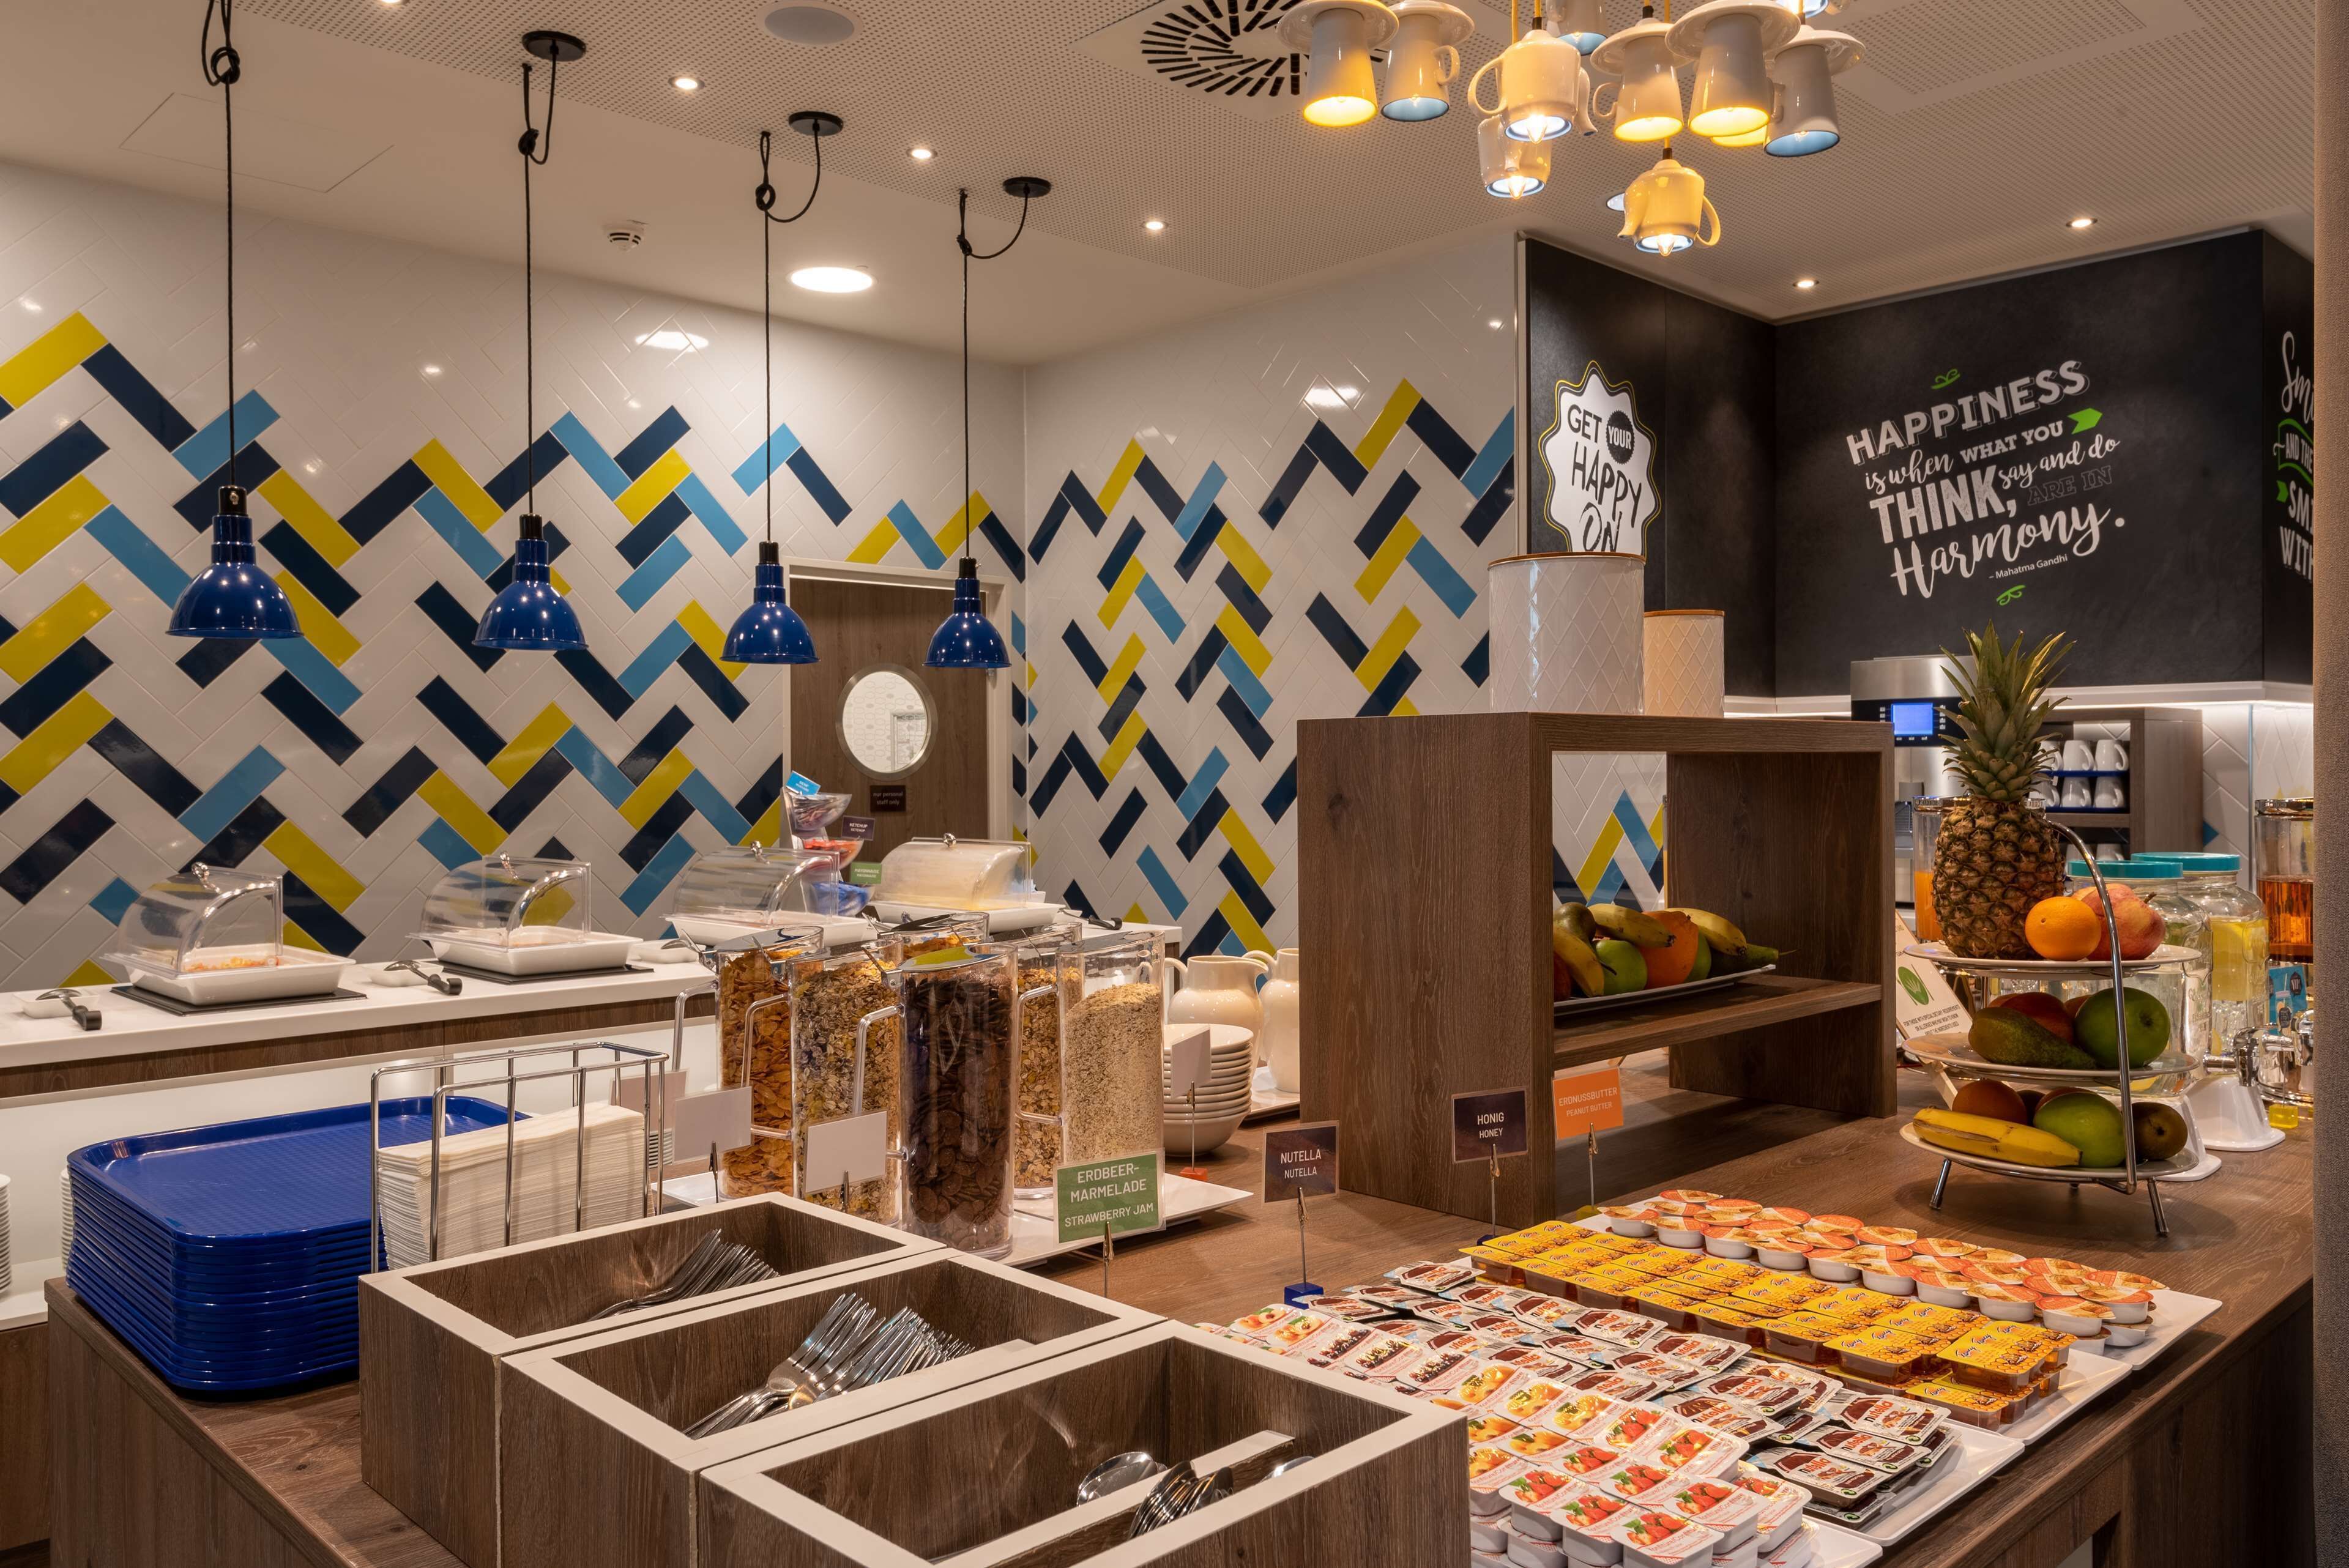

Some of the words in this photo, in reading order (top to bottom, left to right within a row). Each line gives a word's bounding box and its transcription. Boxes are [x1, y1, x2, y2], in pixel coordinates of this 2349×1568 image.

[1847, 360, 2090, 466] HAPPINESS
[1568, 404, 1602, 443] GET
[1608, 425, 1631, 449] YOUR
[2286, 433, 2299, 460] AND
[1865, 471, 1885, 495] is
[1889, 450, 1954, 485] when
[1960, 434, 2017, 464] WHAT
[2022, 420, 2063, 445] YOU
[1998, 463, 2037, 489] say
[2039, 440, 2085, 471] and
[2088, 434, 2121, 459] do
[1572, 441, 1642, 528] HAPPY
[2027, 475, 2077, 507] ARE
[2081, 466, 2113, 491] IN
[1869, 464, 2017, 544] THINK,
[1579, 502, 1622, 552] ON
[1995, 561, 2036, 580] Mahatma
[2036, 554, 2068, 569] Gandhi
[1558, 1087, 1617, 1106] ERDNUSSBUTTER
[1477, 1112, 1504, 1125] HONIG
[1566, 1107, 1589, 1117] PEANUT
[1590, 1102, 1612, 1112] BUTTER
[1479, 1128, 1503, 1139] HONEY
[1281, 1149, 1322, 1164] NUTELLA
[1078, 1164, 1139, 1183] ERDBEER-
[1284, 1167, 1317, 1179] NUTELLA
[1071, 1179, 1147, 1203] MARMELADE
[1065, 1206, 1131, 1227] STRAWBERRY
[1133, 1203, 1153, 1214] JAM
[1475, 1290, 1505, 1304] nutella
[1429, 1304, 1462, 1315] nutella
[1449, 1336, 1478, 1350] utella
[1691, 1404, 1733, 1424] nutella
[1863, 1400, 1894, 1422] nutella
[1841, 1433, 1873, 1451] nutella
[1799, 1458, 1831, 1474] nutella
